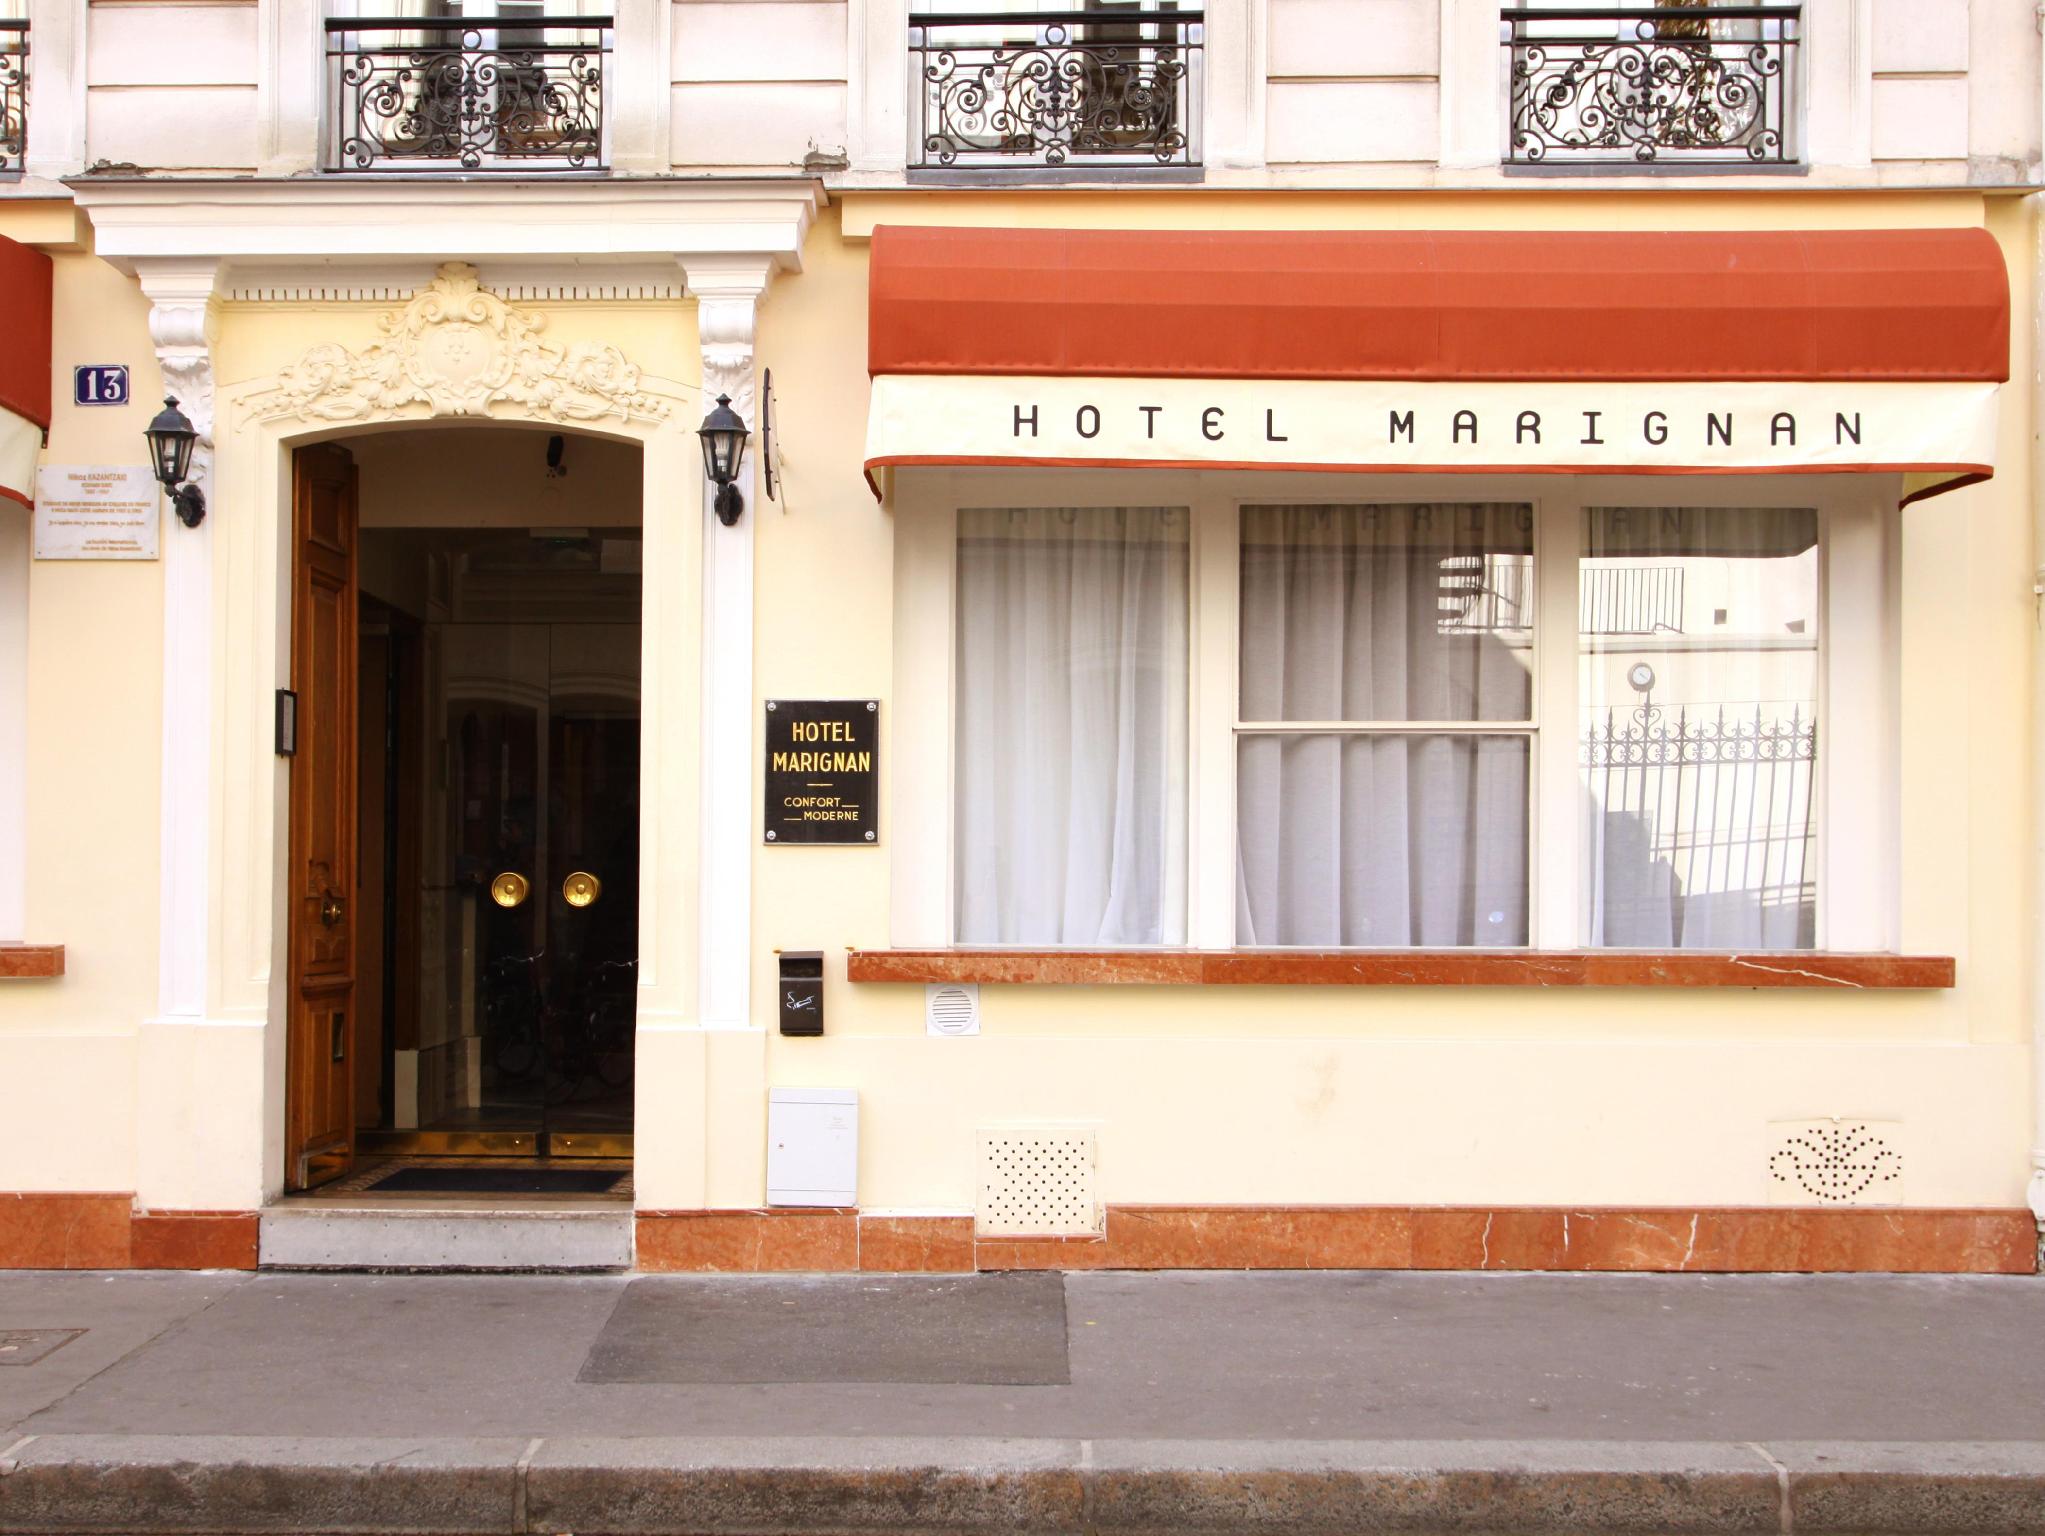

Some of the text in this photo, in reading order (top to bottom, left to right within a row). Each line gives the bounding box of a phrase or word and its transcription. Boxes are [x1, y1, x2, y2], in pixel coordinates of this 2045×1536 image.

[87, 370, 121, 400] 13
[1013, 404, 1861, 446] HOTEL MARIGNAN
[792, 721, 856, 742] HOTEL
[773, 751, 871, 772] MARIGNAN
[784, 797, 841, 808] CONFORT
[803, 811, 859, 821] MODERNE
